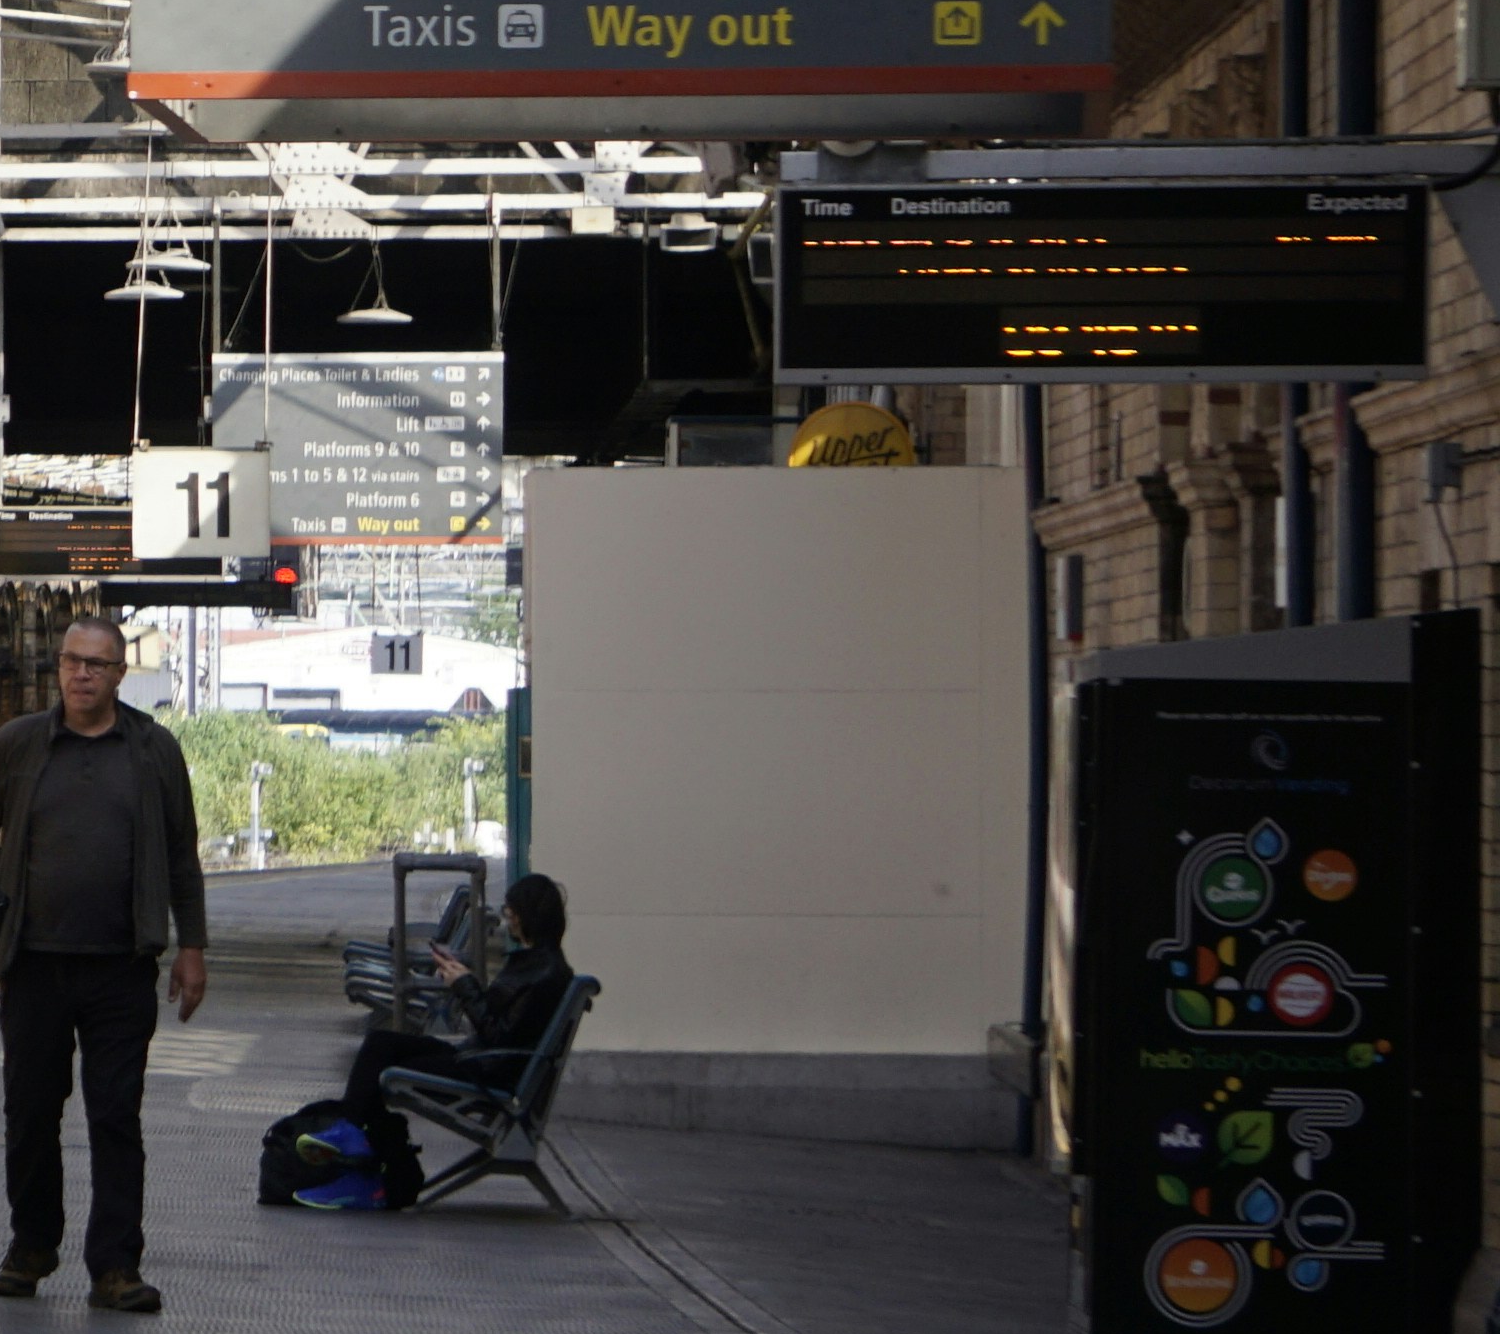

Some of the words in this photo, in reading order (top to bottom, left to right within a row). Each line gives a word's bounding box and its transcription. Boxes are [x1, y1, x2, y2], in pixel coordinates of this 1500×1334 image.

[364, 5, 476, 47] Taxis
[587, 5, 692, 57] Way
[709, 7, 792, 46] out
[800, 199, 853, 216] Time
[891, 197, 1009, 214] Destination
[1307, 193, 1407, 214] Expected
[219, 365, 277, 387] Changing
[282, 367, 320, 382] Places
[325, 368, 356, 382] Toilet
[361, 369, 370, 381] &
[376, 366, 419, 382] Ladies
[338, 391, 419, 408] Information
[397, 416, 419, 433] Lift
[304, 441, 371, 458] Platforms
[375, 442, 384, 457] 9
[389, 442, 399, 456] &
[405, 442, 419, 456] 10
[292, 467, 298, 483] 1
[304, 469, 319, 483] to
[324, 467, 332, 482] 5
[337, 467, 346, 483] &
[352, 467, 367, 482] 12
[372, 470, 388, 483] via
[390, 470, 419, 482] stairs
[176, 471, 231, 538] 11
[347, 491, 406, 508] Platform
[411, 492, 419, 508] 6
[291, 517, 326, 533] Taxis
[358, 517, 390, 535] Way
[394, 517, 419, 532] out
[384, 639, 411, 671] 11
